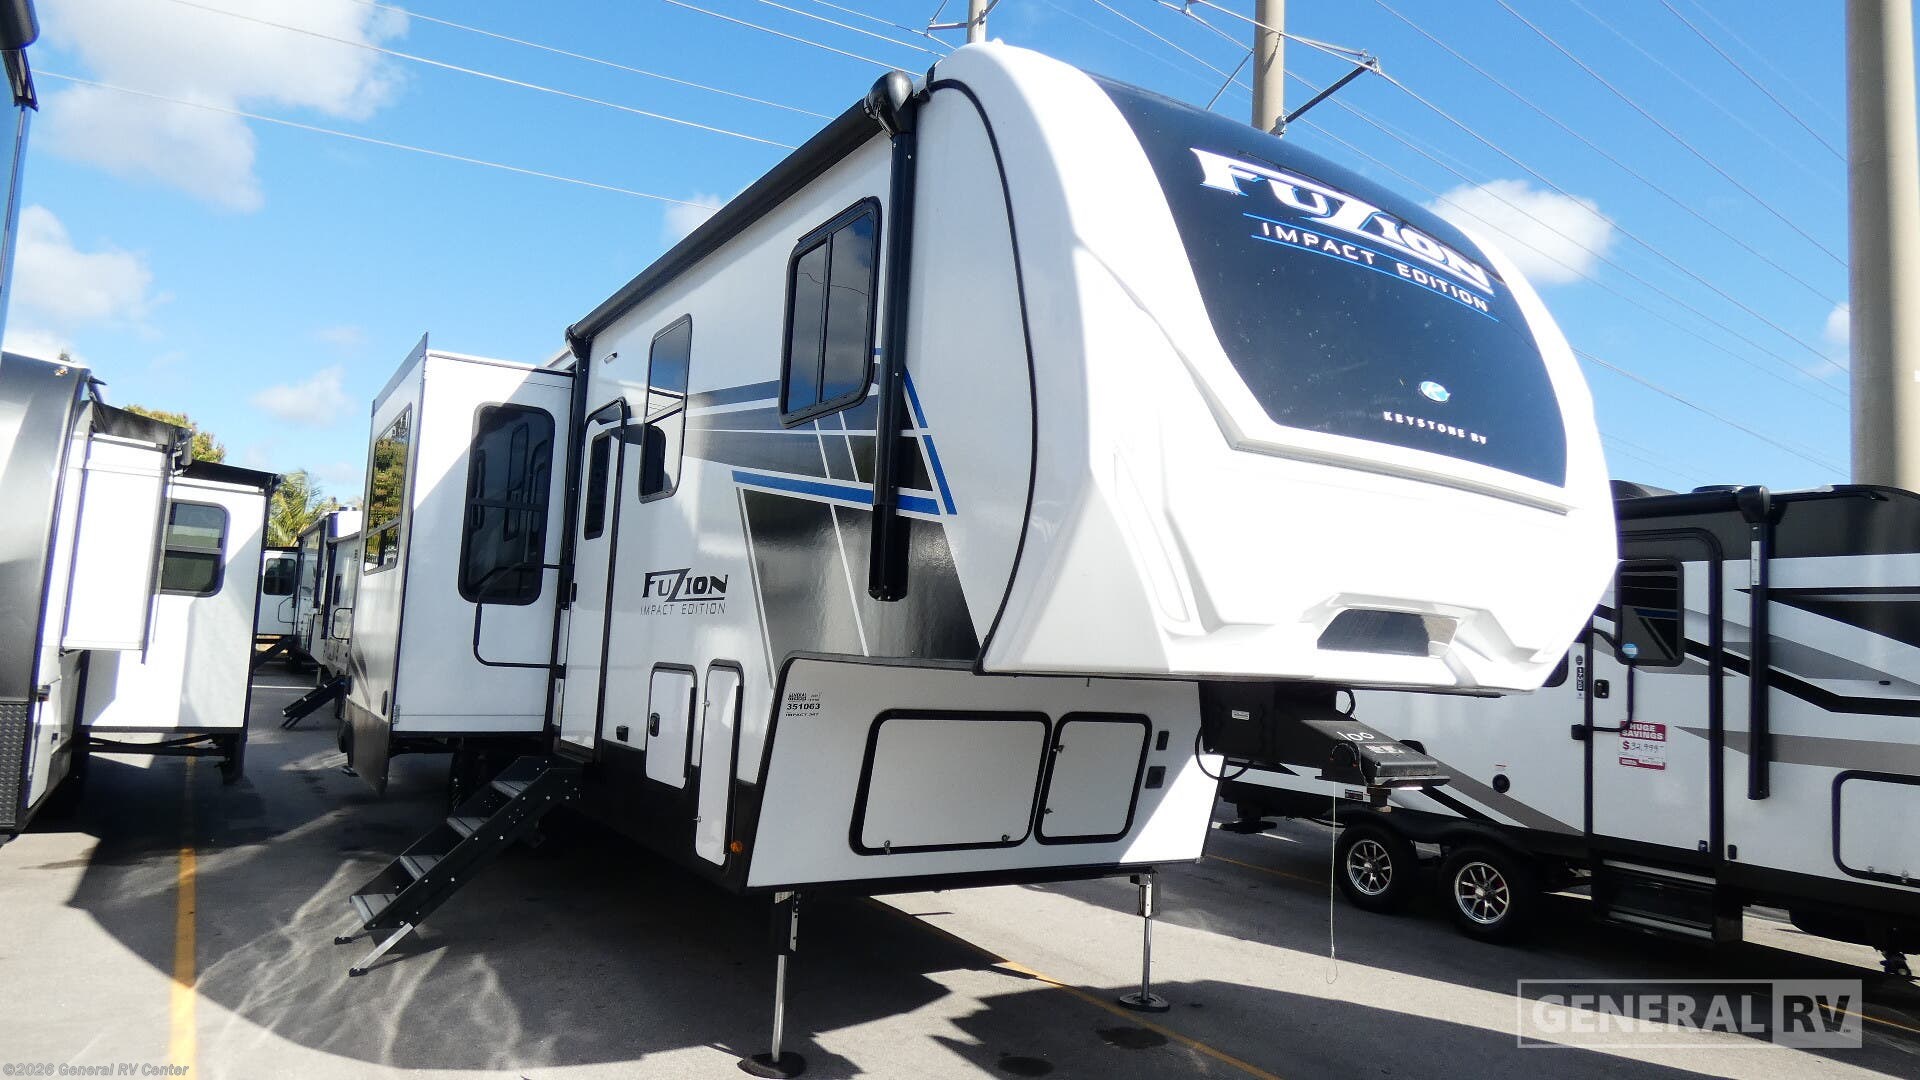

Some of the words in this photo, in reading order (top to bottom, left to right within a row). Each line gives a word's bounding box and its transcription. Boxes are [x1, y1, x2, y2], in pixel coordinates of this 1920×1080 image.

[1261, 222, 1375, 265] IMPACT
[1396, 262, 1488, 312] EDITION
[1383, 411, 1465, 438] KEYSTONE
[1470, 432, 1487, 445] RV
[640, 604, 674, 616] IMPACT
[681, 602, 726, 615] EDITION
[1621, 730, 1665, 740] SAVINGS
[1629, 724, 1655, 732] HUGE
